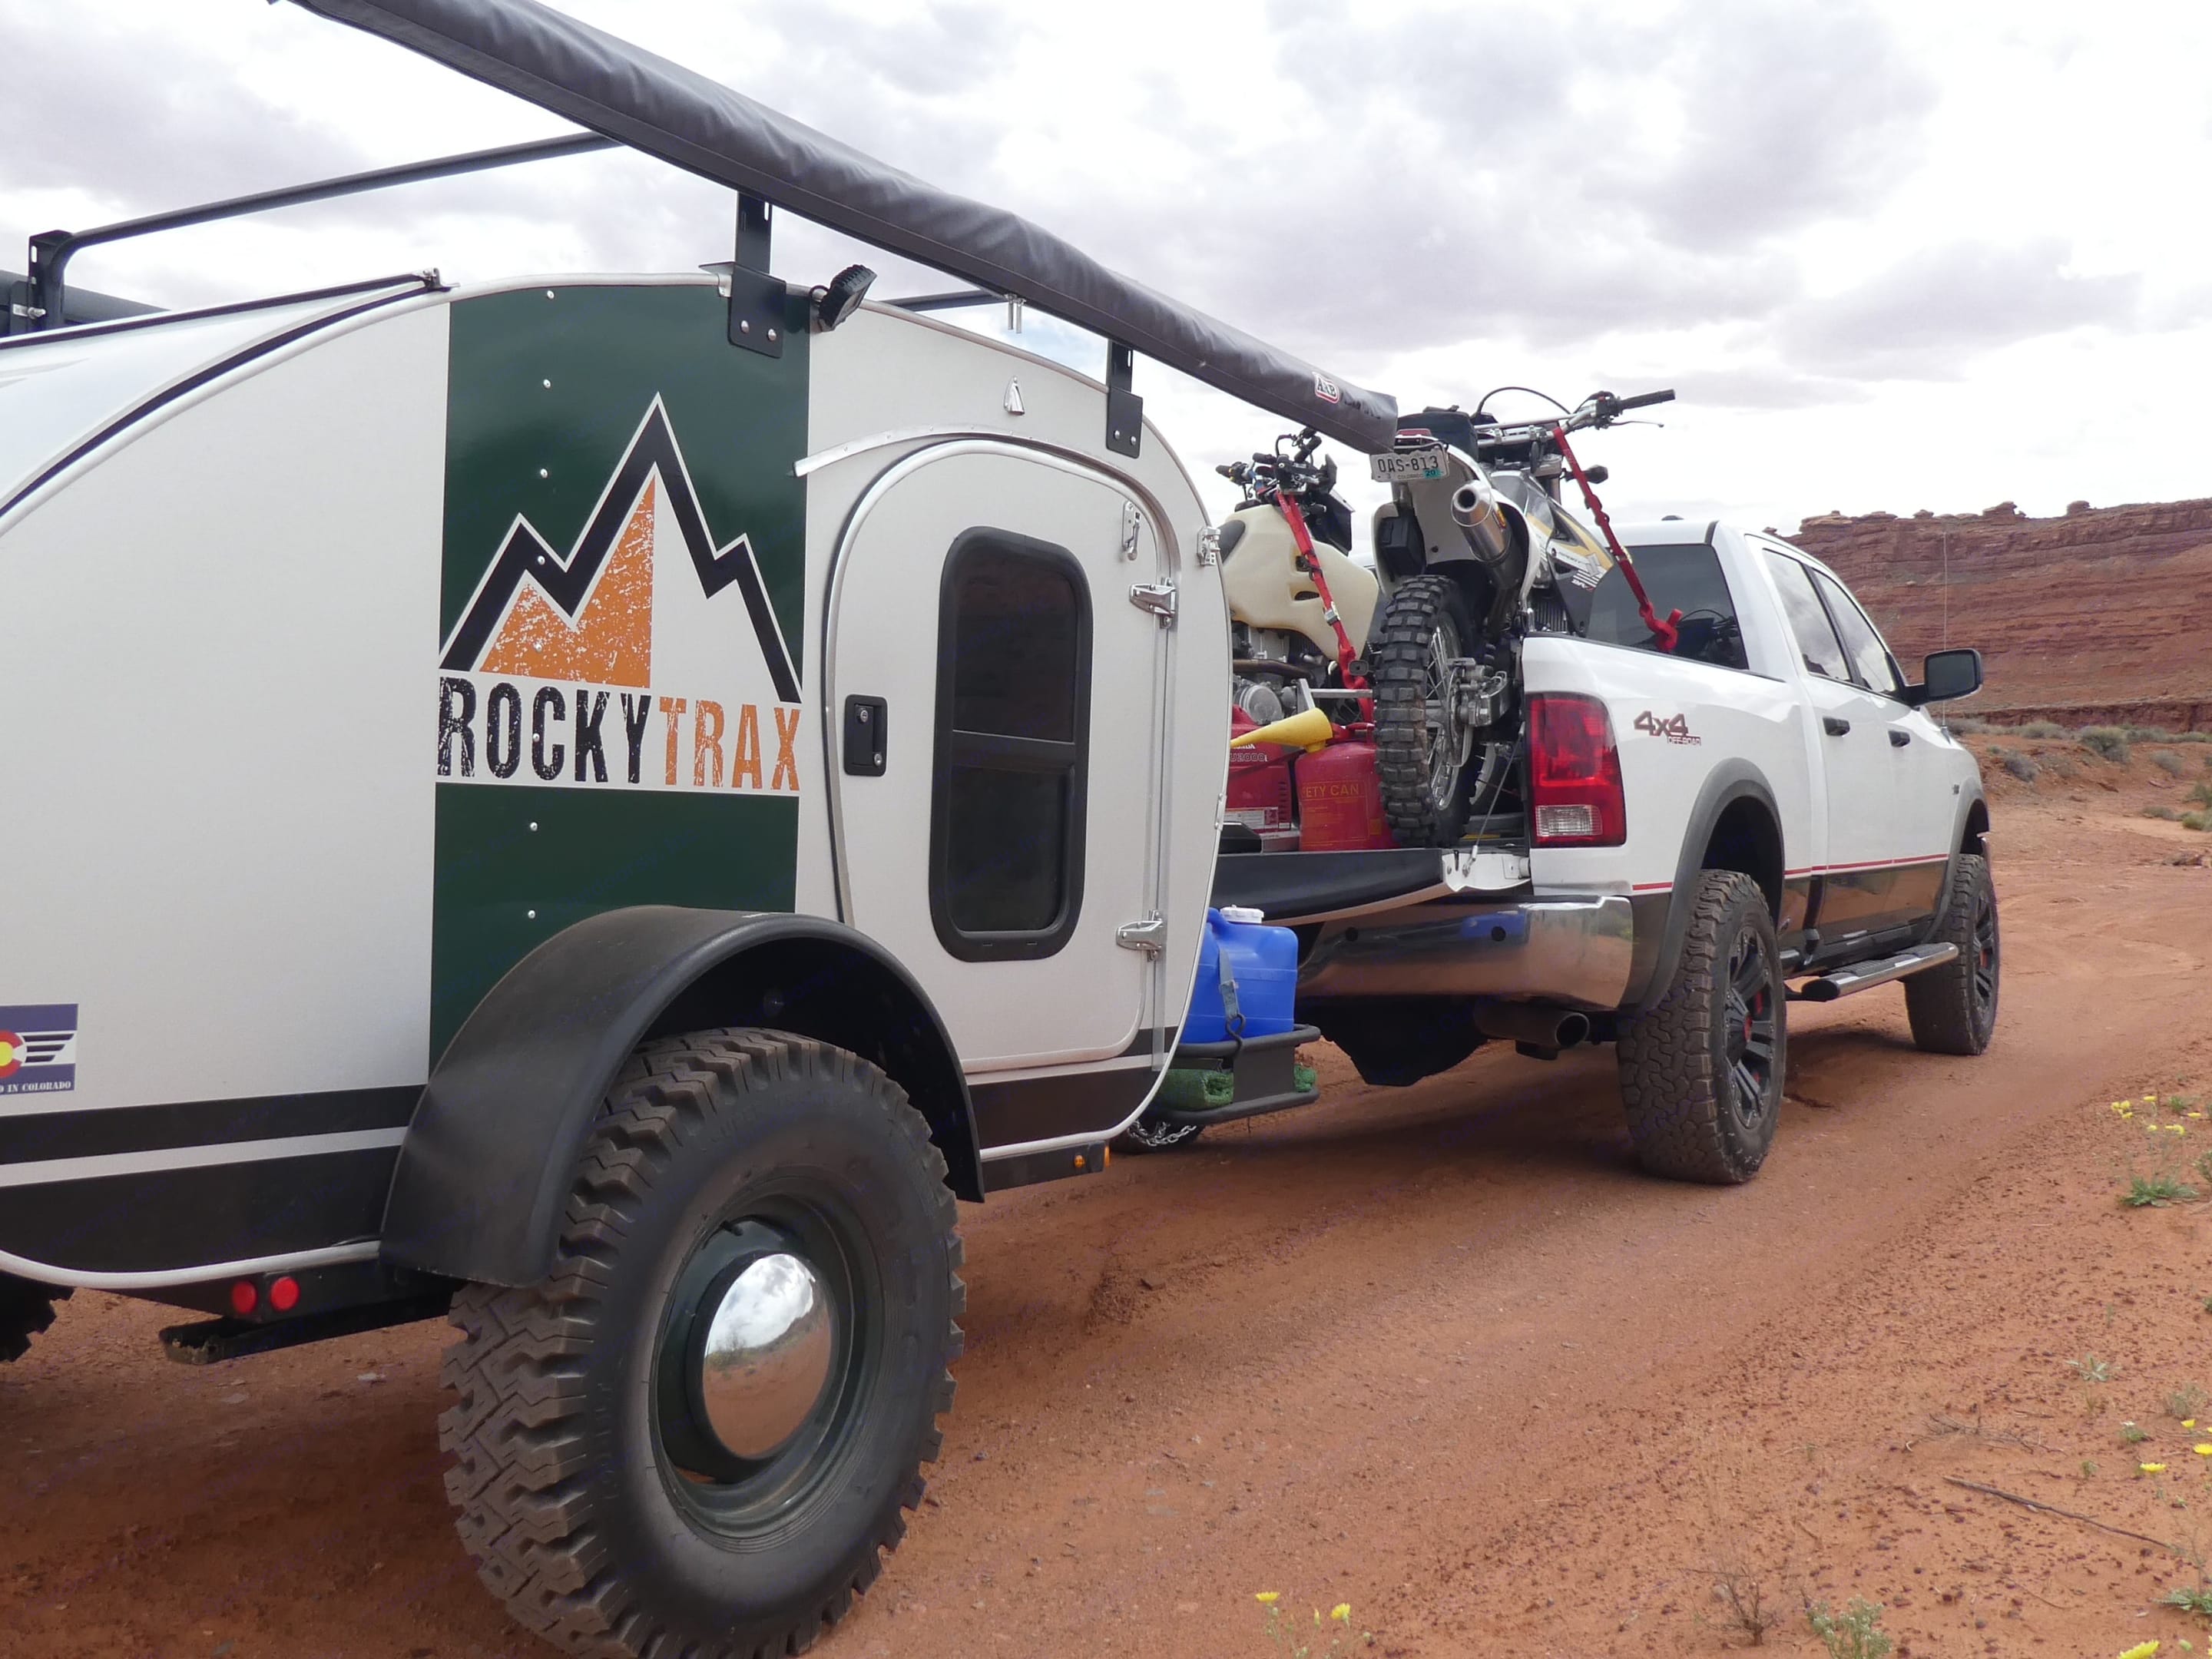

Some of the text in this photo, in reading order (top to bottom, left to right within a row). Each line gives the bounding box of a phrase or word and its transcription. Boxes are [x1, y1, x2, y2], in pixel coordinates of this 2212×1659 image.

[1330, 783, 1359, 796] CAN
[8, 1084, 18, 1093] IN
[22, 1081, 71, 1091] COLORADO
